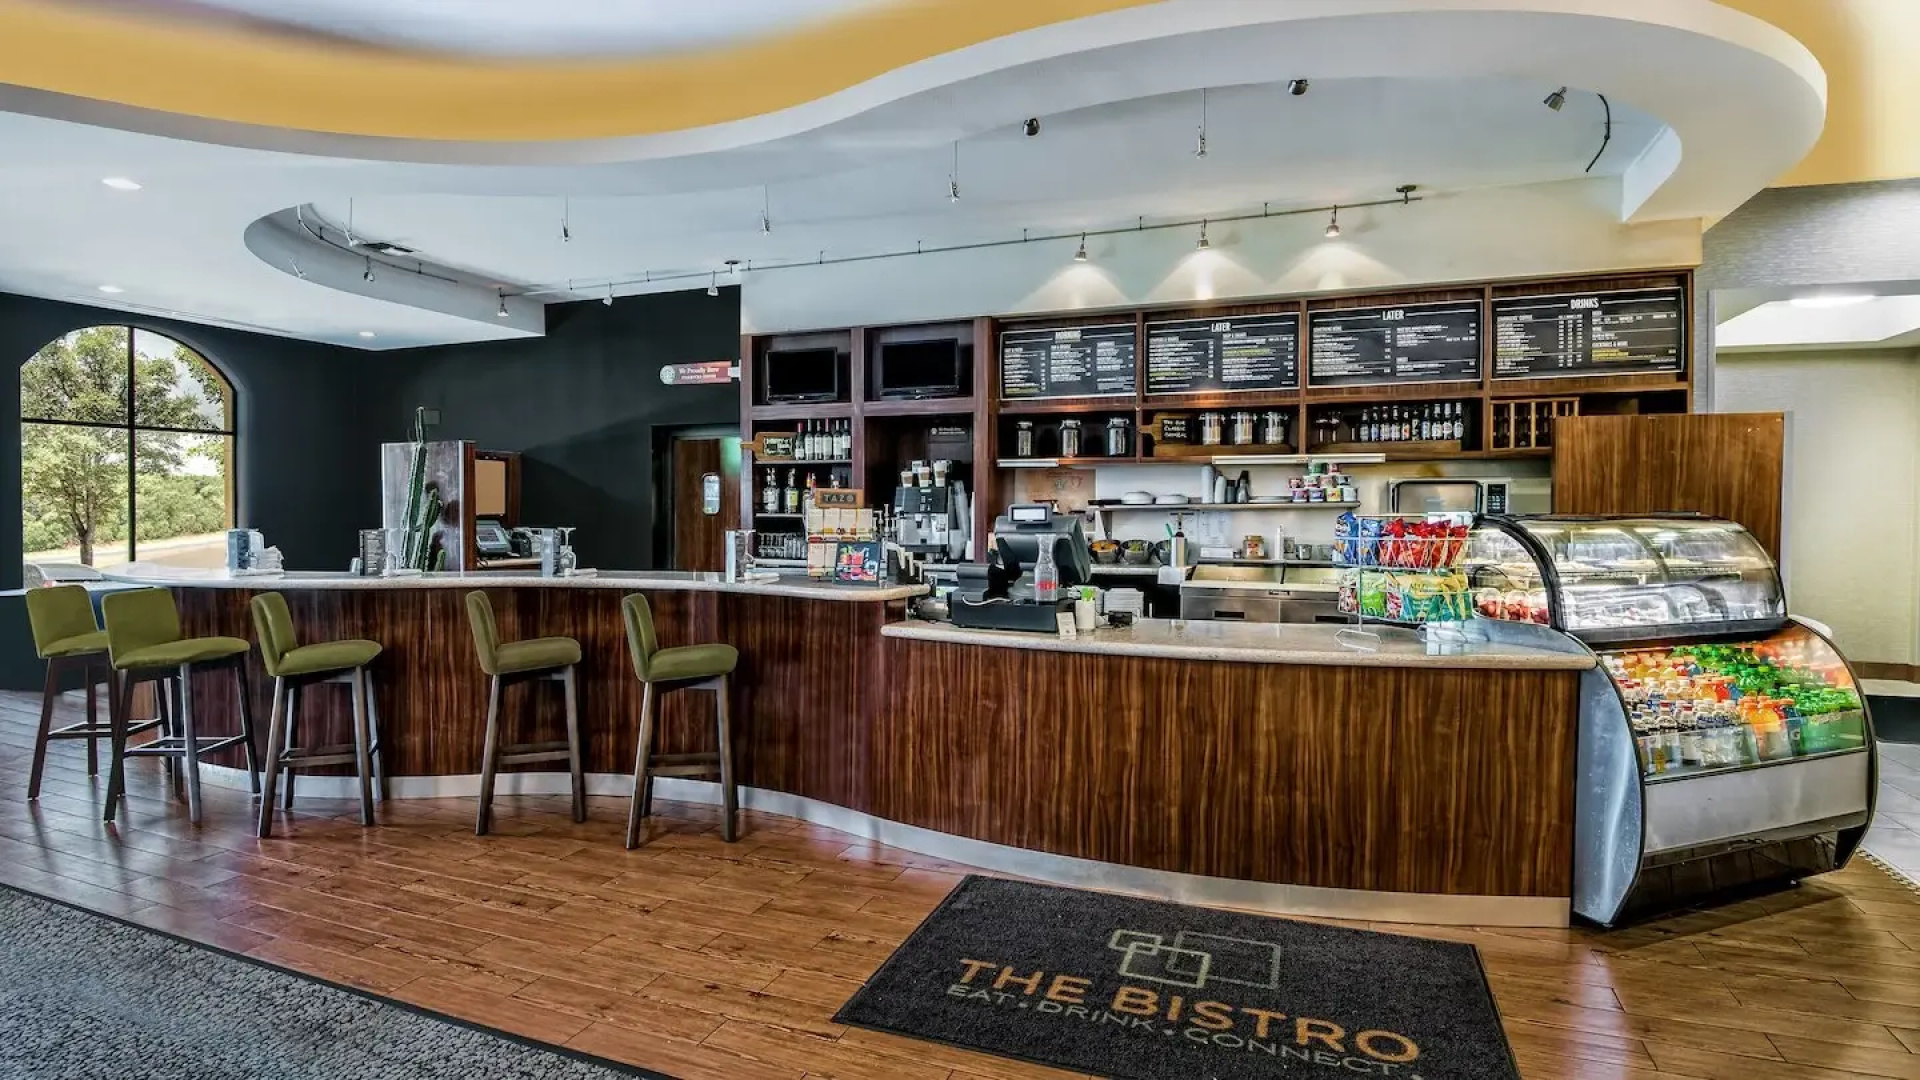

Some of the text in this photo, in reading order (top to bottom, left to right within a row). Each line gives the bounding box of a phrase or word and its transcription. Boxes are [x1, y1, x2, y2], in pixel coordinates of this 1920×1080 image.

[1571, 297, 1599, 309] DRINKS
[1383, 310, 1404, 321] LATER
[1211, 322, 1231, 333] LATER
[823, 494, 854, 502] TAZO
[959, 958, 1420, 1063] THE BISTRO
[1036, 999, 1154, 1033] DRINK
